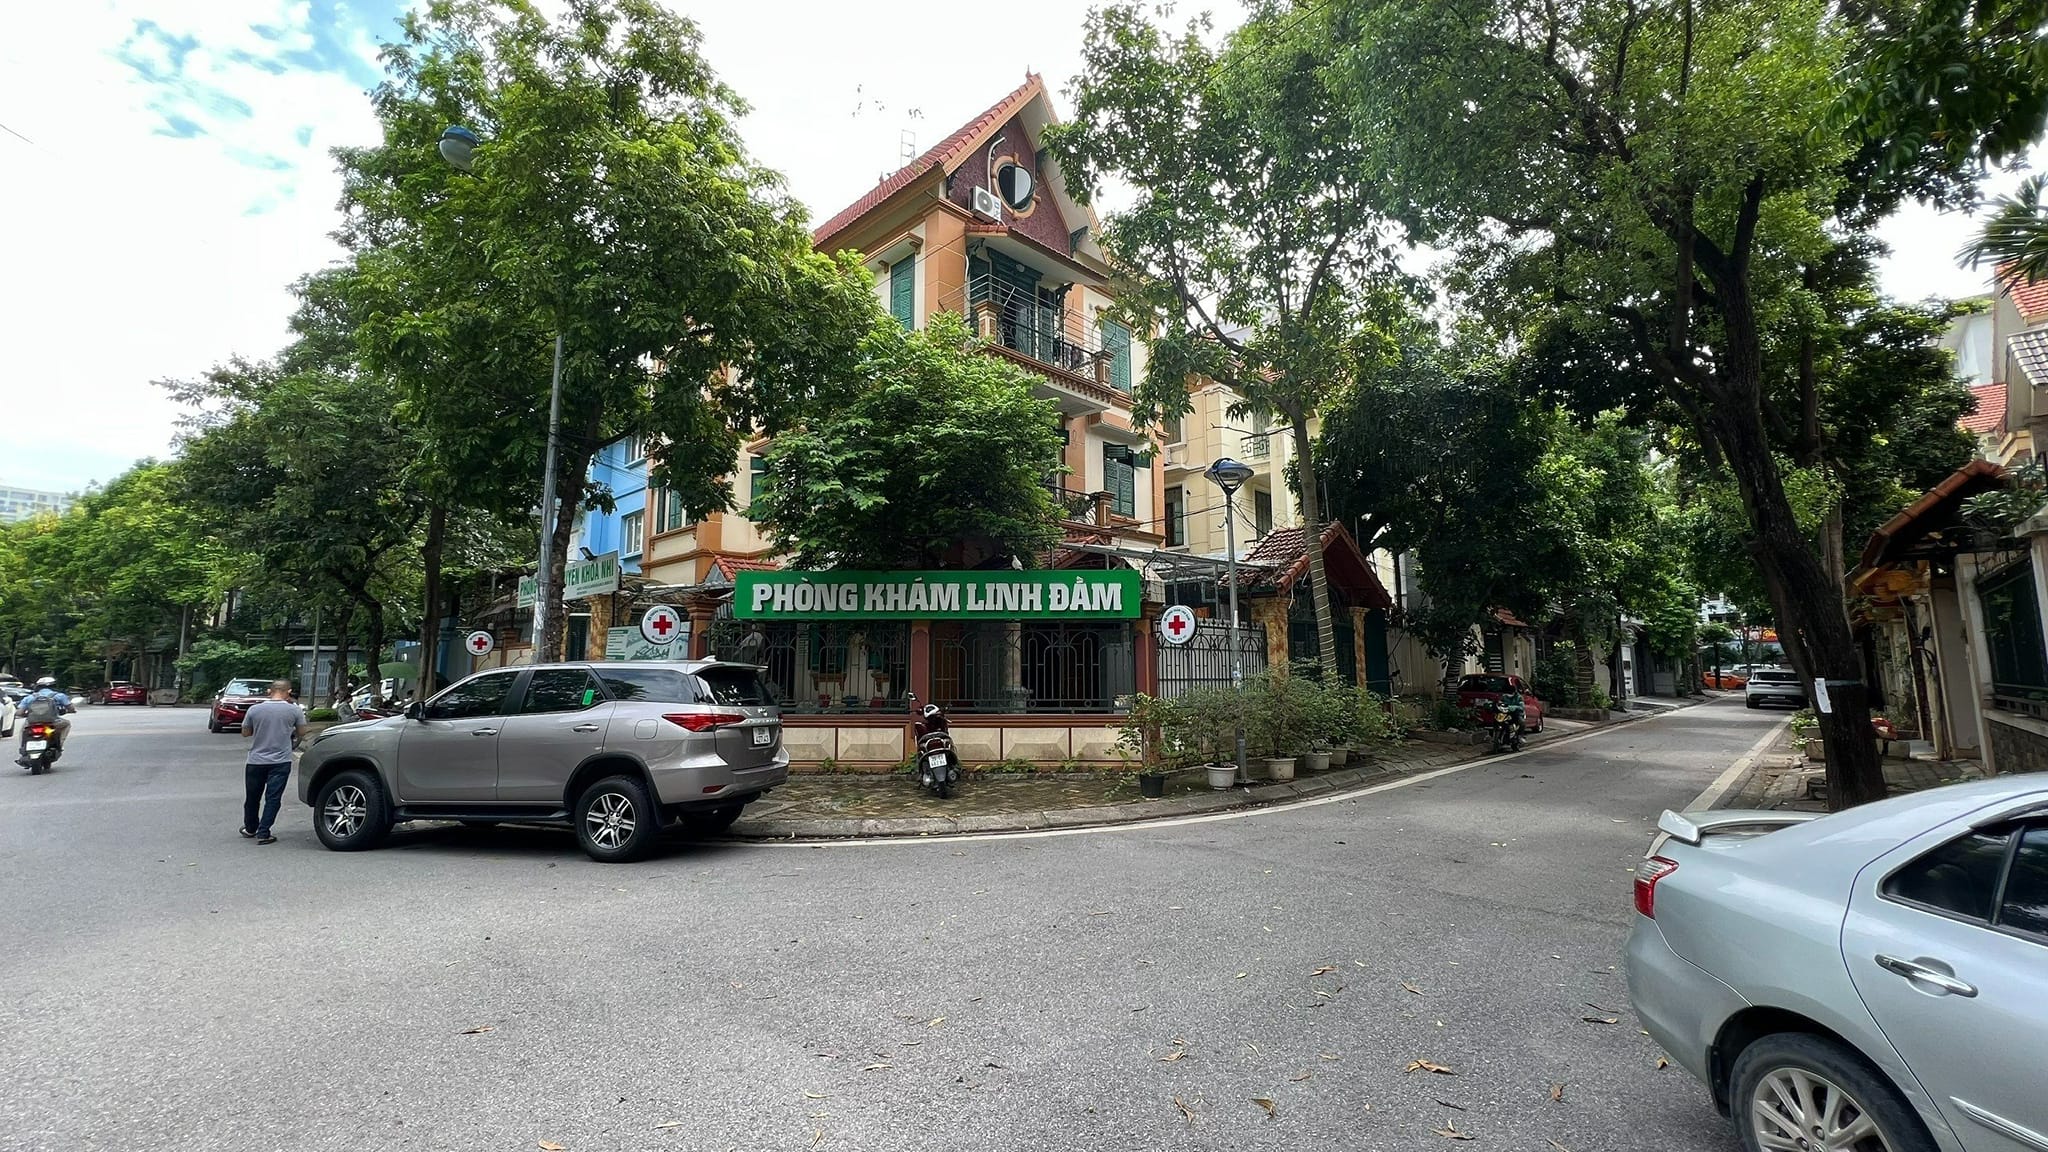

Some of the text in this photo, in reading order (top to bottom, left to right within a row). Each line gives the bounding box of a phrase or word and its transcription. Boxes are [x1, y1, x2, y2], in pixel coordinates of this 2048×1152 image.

[581, 561, 599, 583] KHOA
[600, 557, 614, 579] NHI
[751, 577, 858, 611] PHÒNG
[864, 577, 960, 611] KHÁM
[966, 583, 1042, 611] LINH
